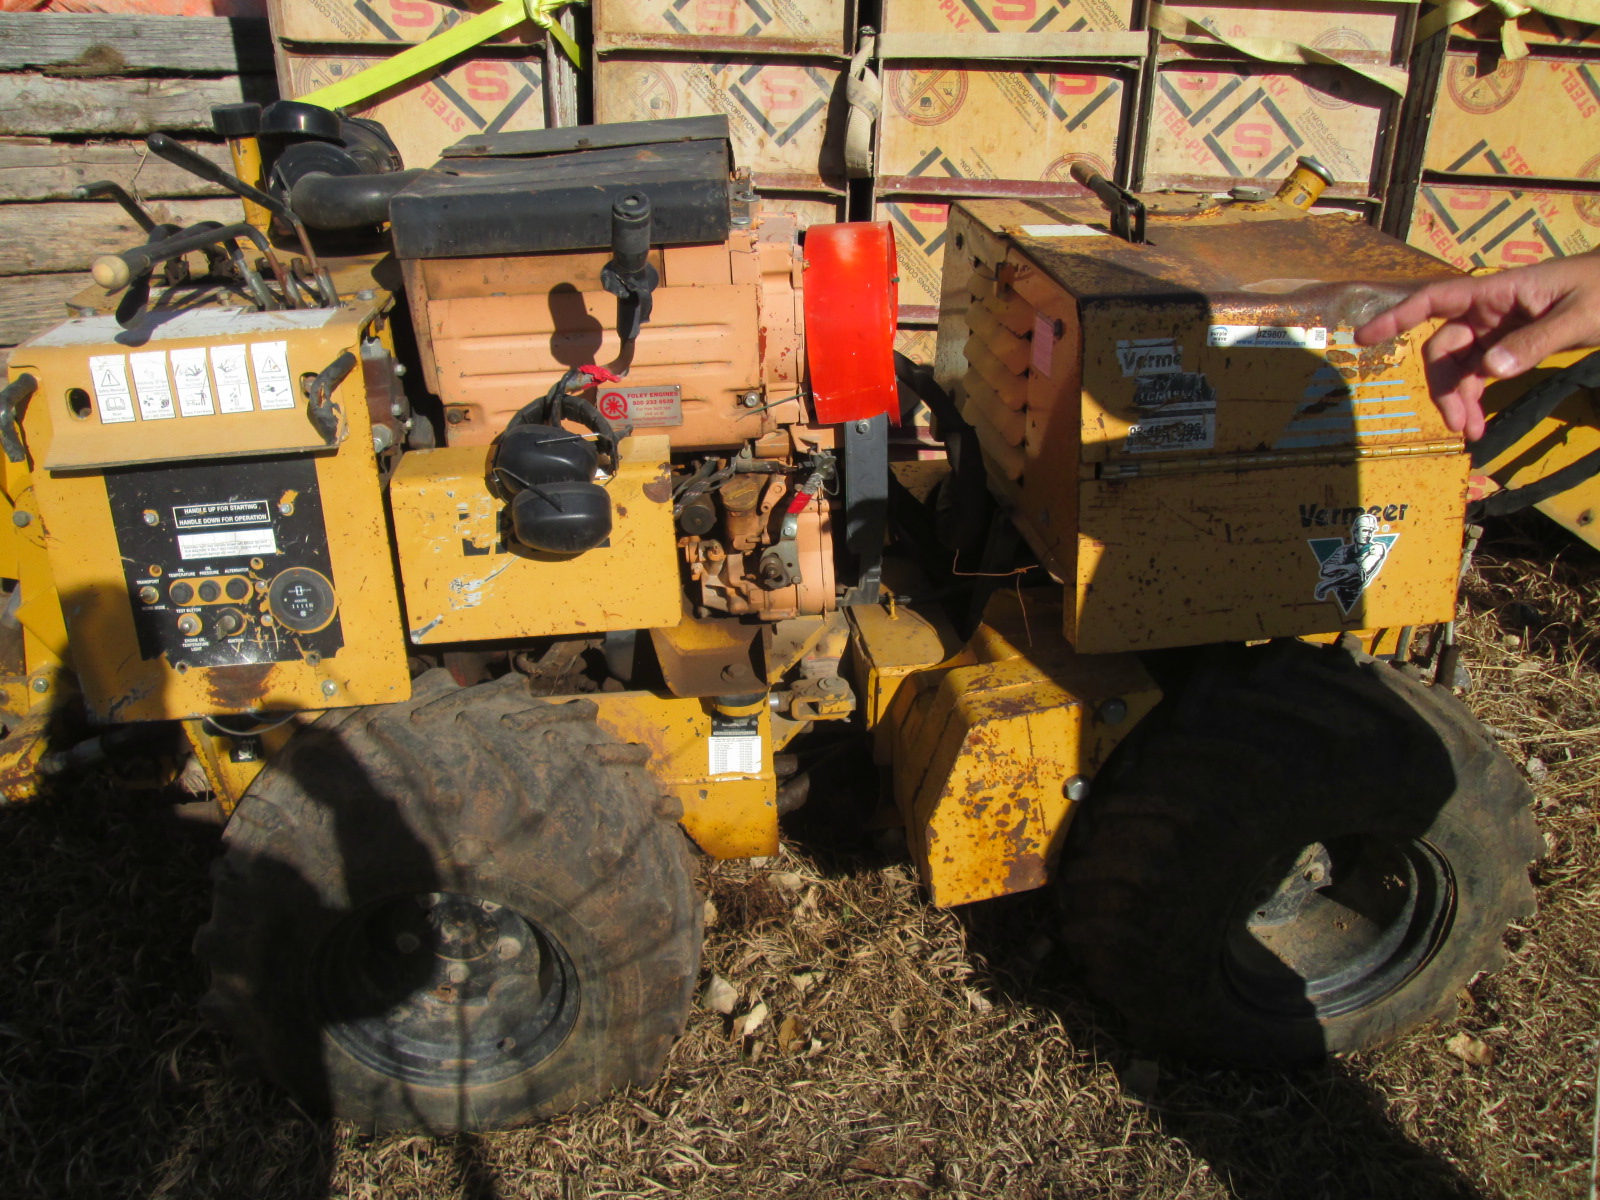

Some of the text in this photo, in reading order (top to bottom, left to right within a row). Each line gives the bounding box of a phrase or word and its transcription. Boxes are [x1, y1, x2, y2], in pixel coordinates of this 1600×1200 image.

[465, 62, 510, 102] S
[1008, 72, 1047, 119] CORPORATION
[716, 88, 756, 135] CORPORATION
[1231, 123, 1273, 158] S
[179, 518, 202, 526] HANDLE
[234, 514, 266, 522] OPERATION
[230, 503, 257, 511] STARTING
[1299, 503, 1408, 527] Vermeer
